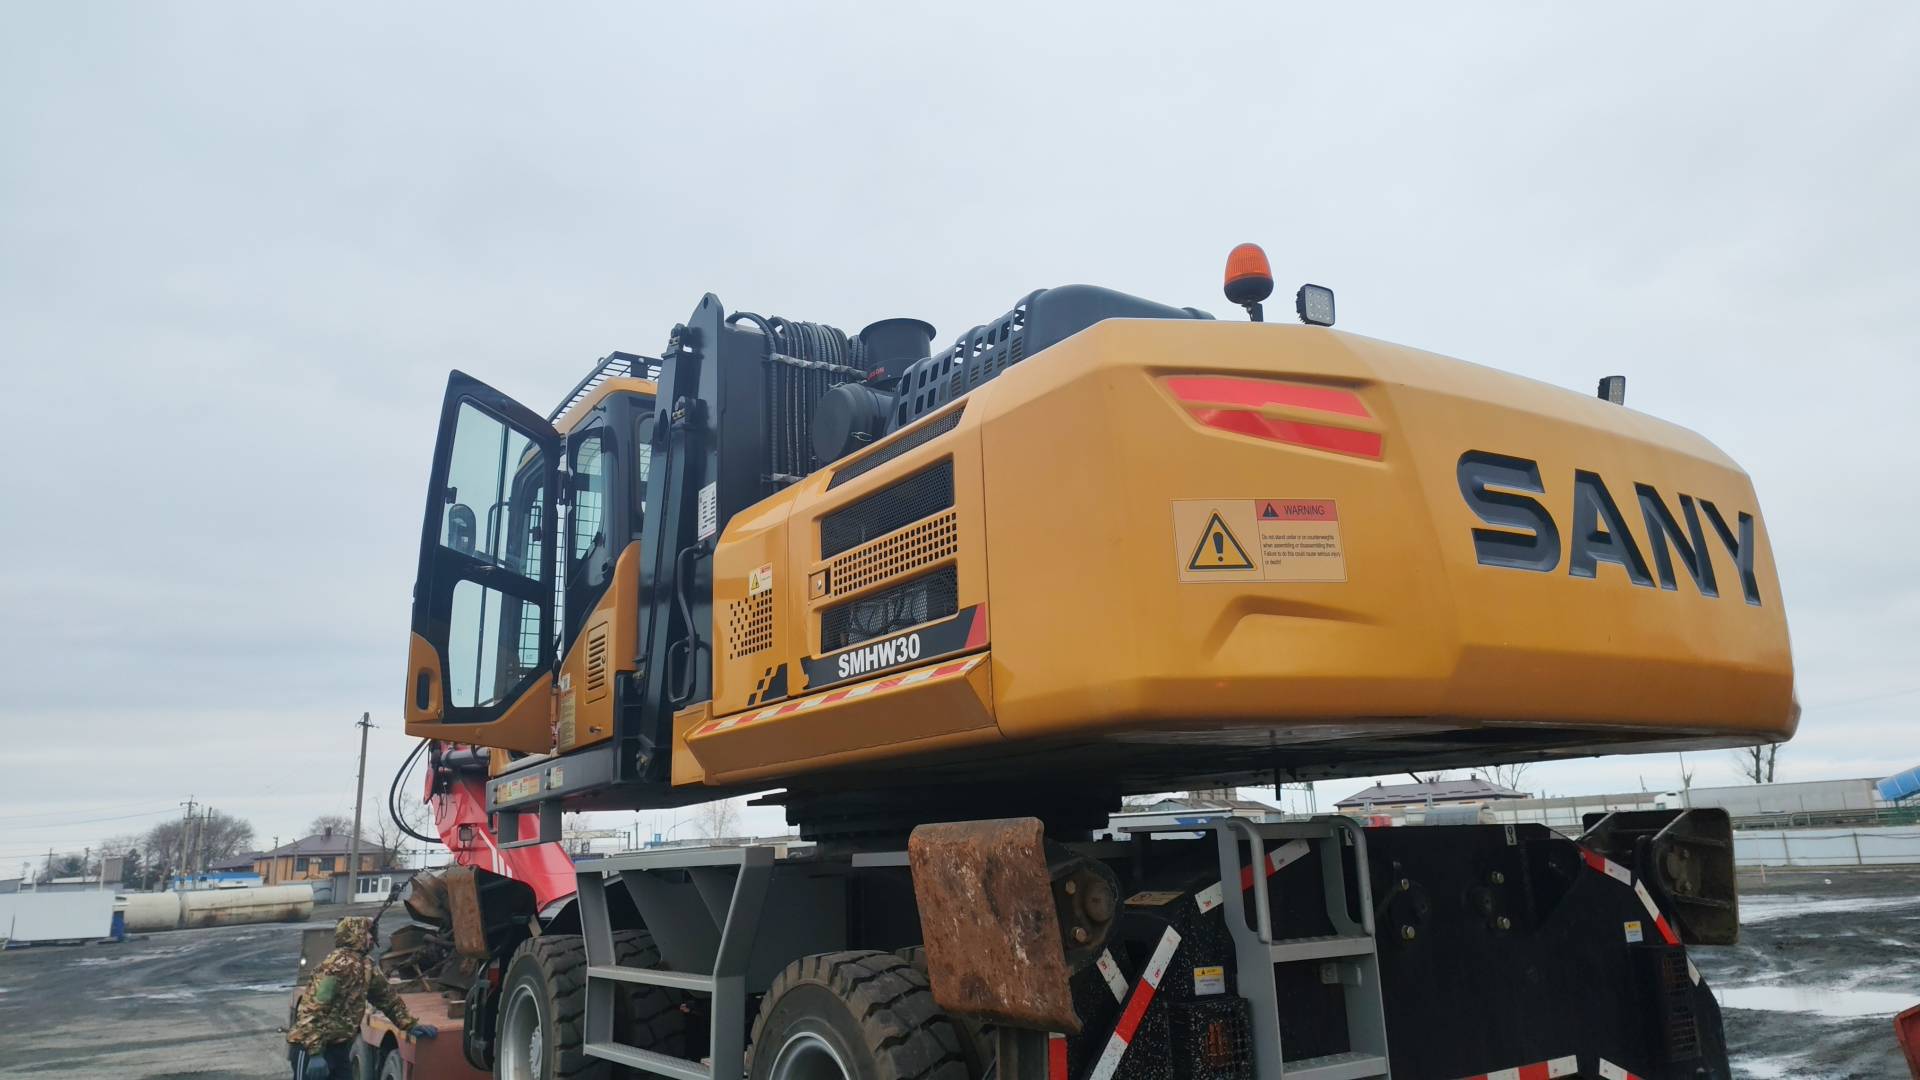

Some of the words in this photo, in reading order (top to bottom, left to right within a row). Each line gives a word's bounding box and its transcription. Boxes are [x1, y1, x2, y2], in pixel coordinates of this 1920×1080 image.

[1284, 504, 1326, 516] WARNING
[1456, 449, 1762, 607] SANY
[838, 633, 920, 678] SMHW30
